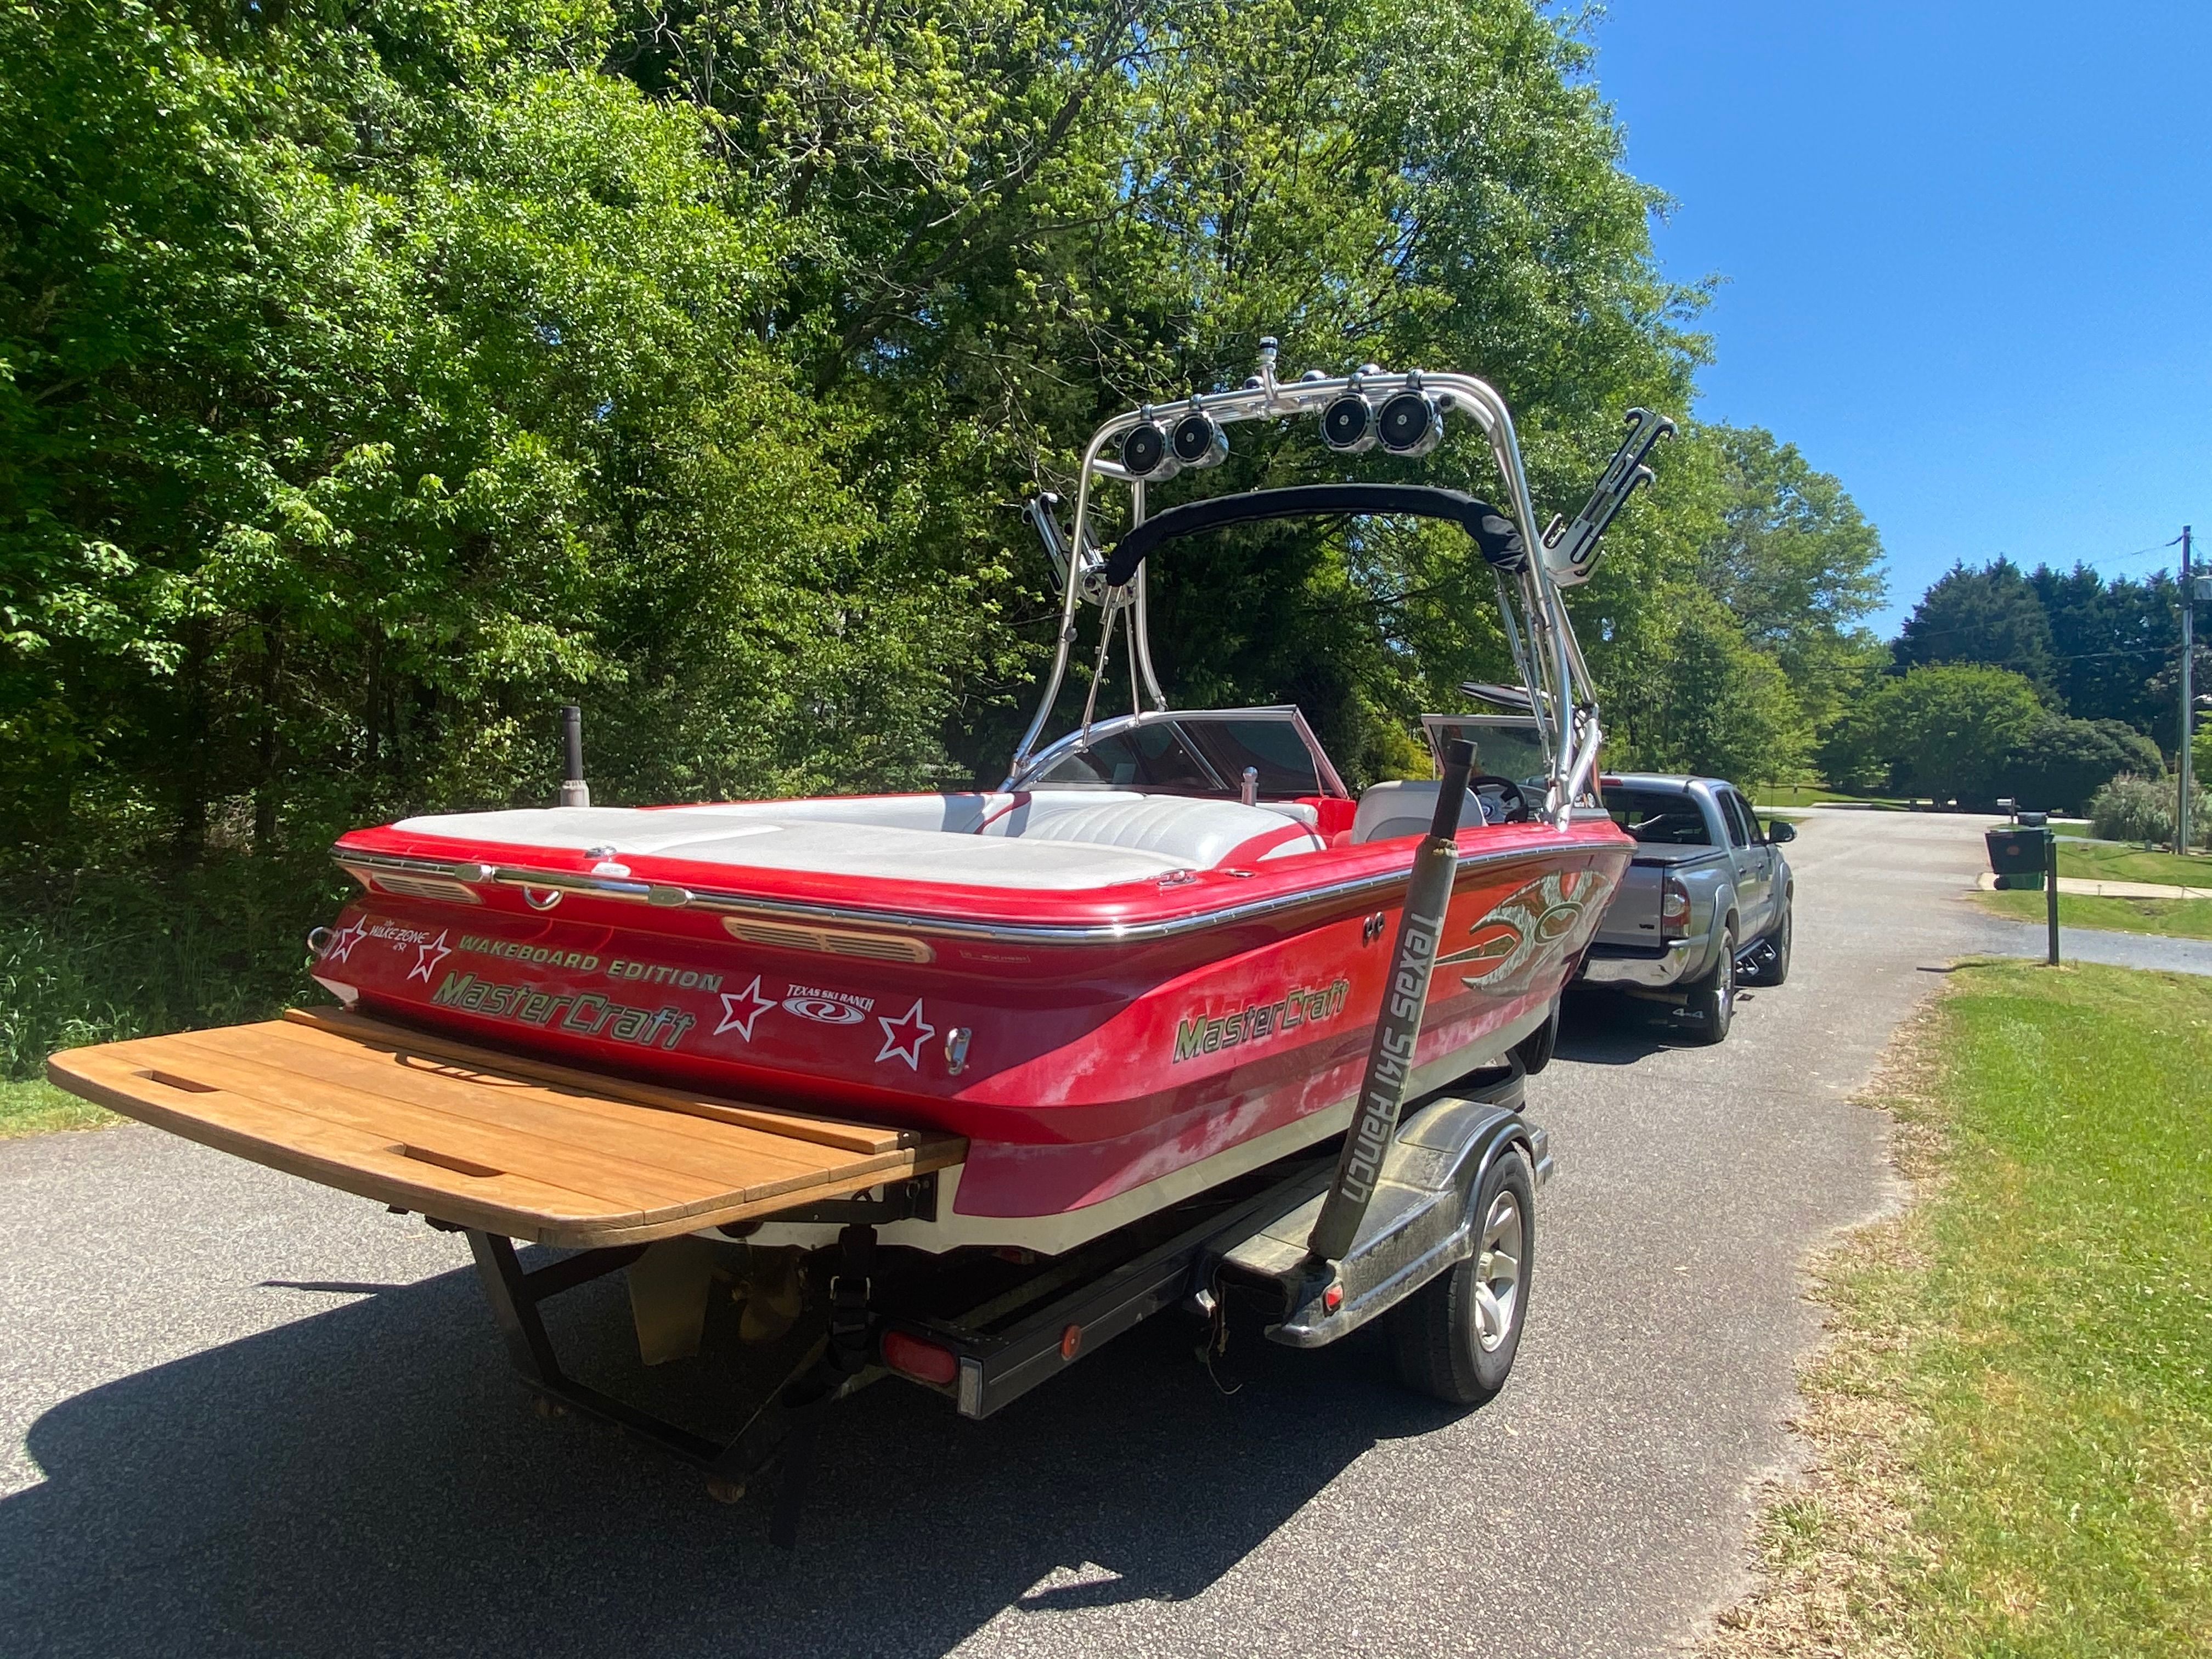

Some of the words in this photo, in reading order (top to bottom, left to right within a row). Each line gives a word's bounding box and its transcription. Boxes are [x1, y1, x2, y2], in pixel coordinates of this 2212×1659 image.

[370, 925, 397, 939] WAKE
[394, 929, 430, 943] ZONE
[458, 934, 600, 972] WAKEBOARD
[607, 960, 724, 993] EDITION
[430, 970, 695, 1049] MasterCraft
[787, 984, 821, 997] TEXAS
[821, 990, 838, 1001] SKI
[839, 994, 874, 1012] RANCH
[1172, 979, 1349, 1063] MasterCraft
